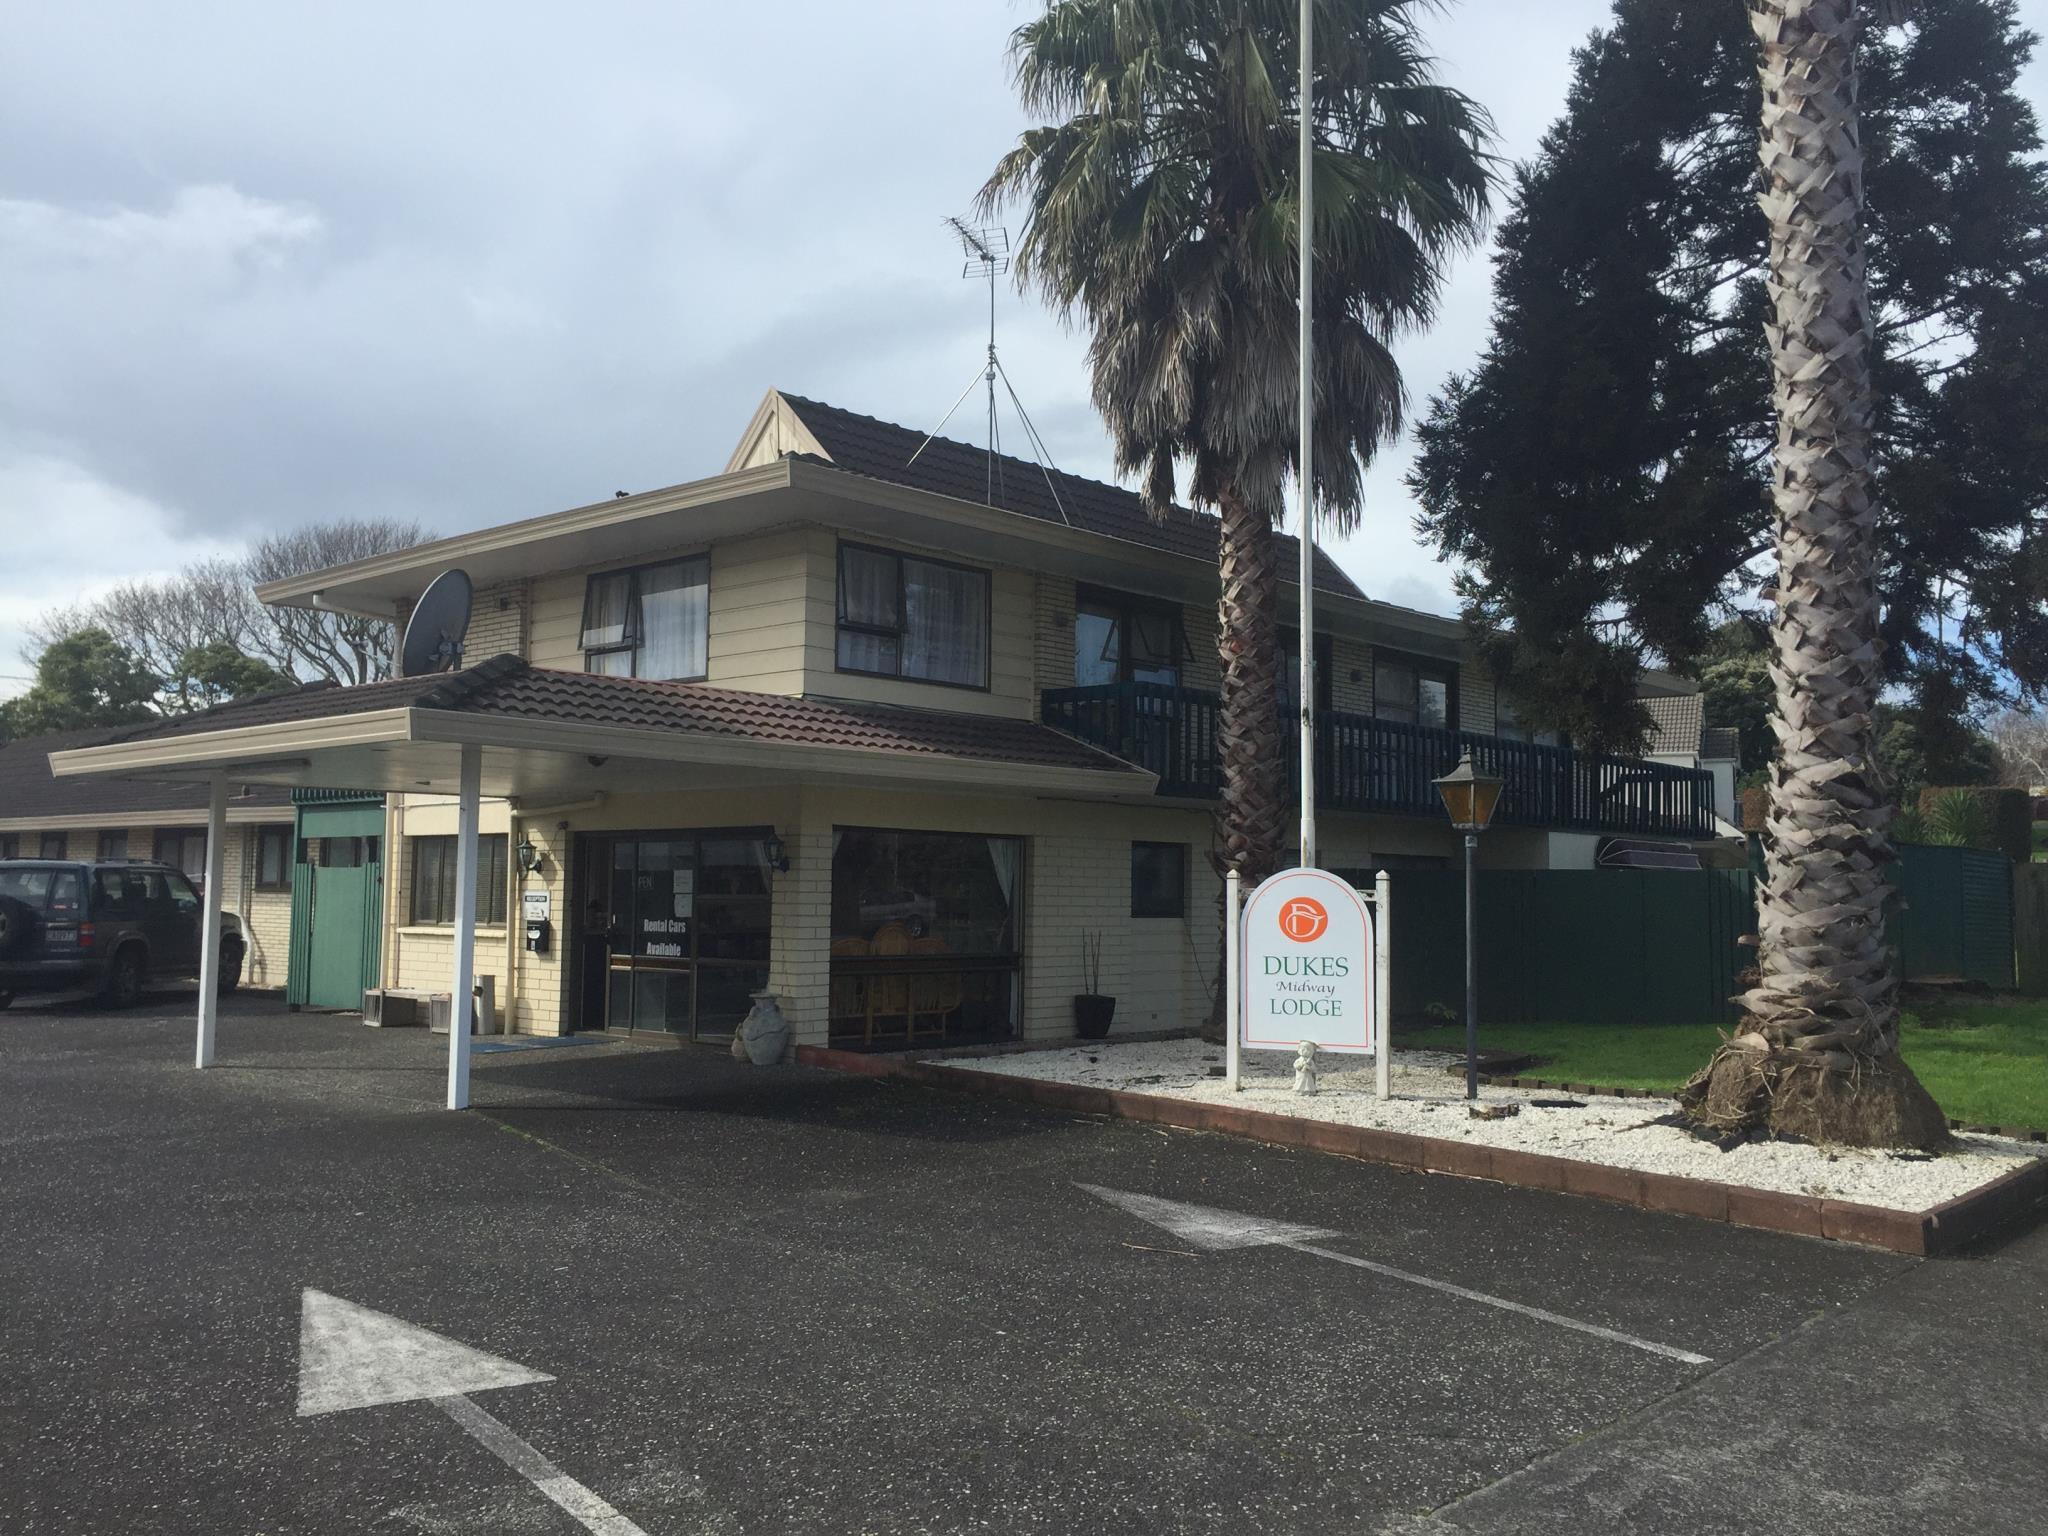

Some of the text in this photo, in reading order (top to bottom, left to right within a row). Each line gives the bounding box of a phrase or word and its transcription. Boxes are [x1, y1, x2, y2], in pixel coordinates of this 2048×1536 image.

[644, 919, 686, 933] Rental Cars
[646, 942, 681, 956] Available
[1264, 955, 1349, 977] DUKES
[1275, 979, 1336, 998] Midway
[1270, 998, 1342, 1017] LODGE
